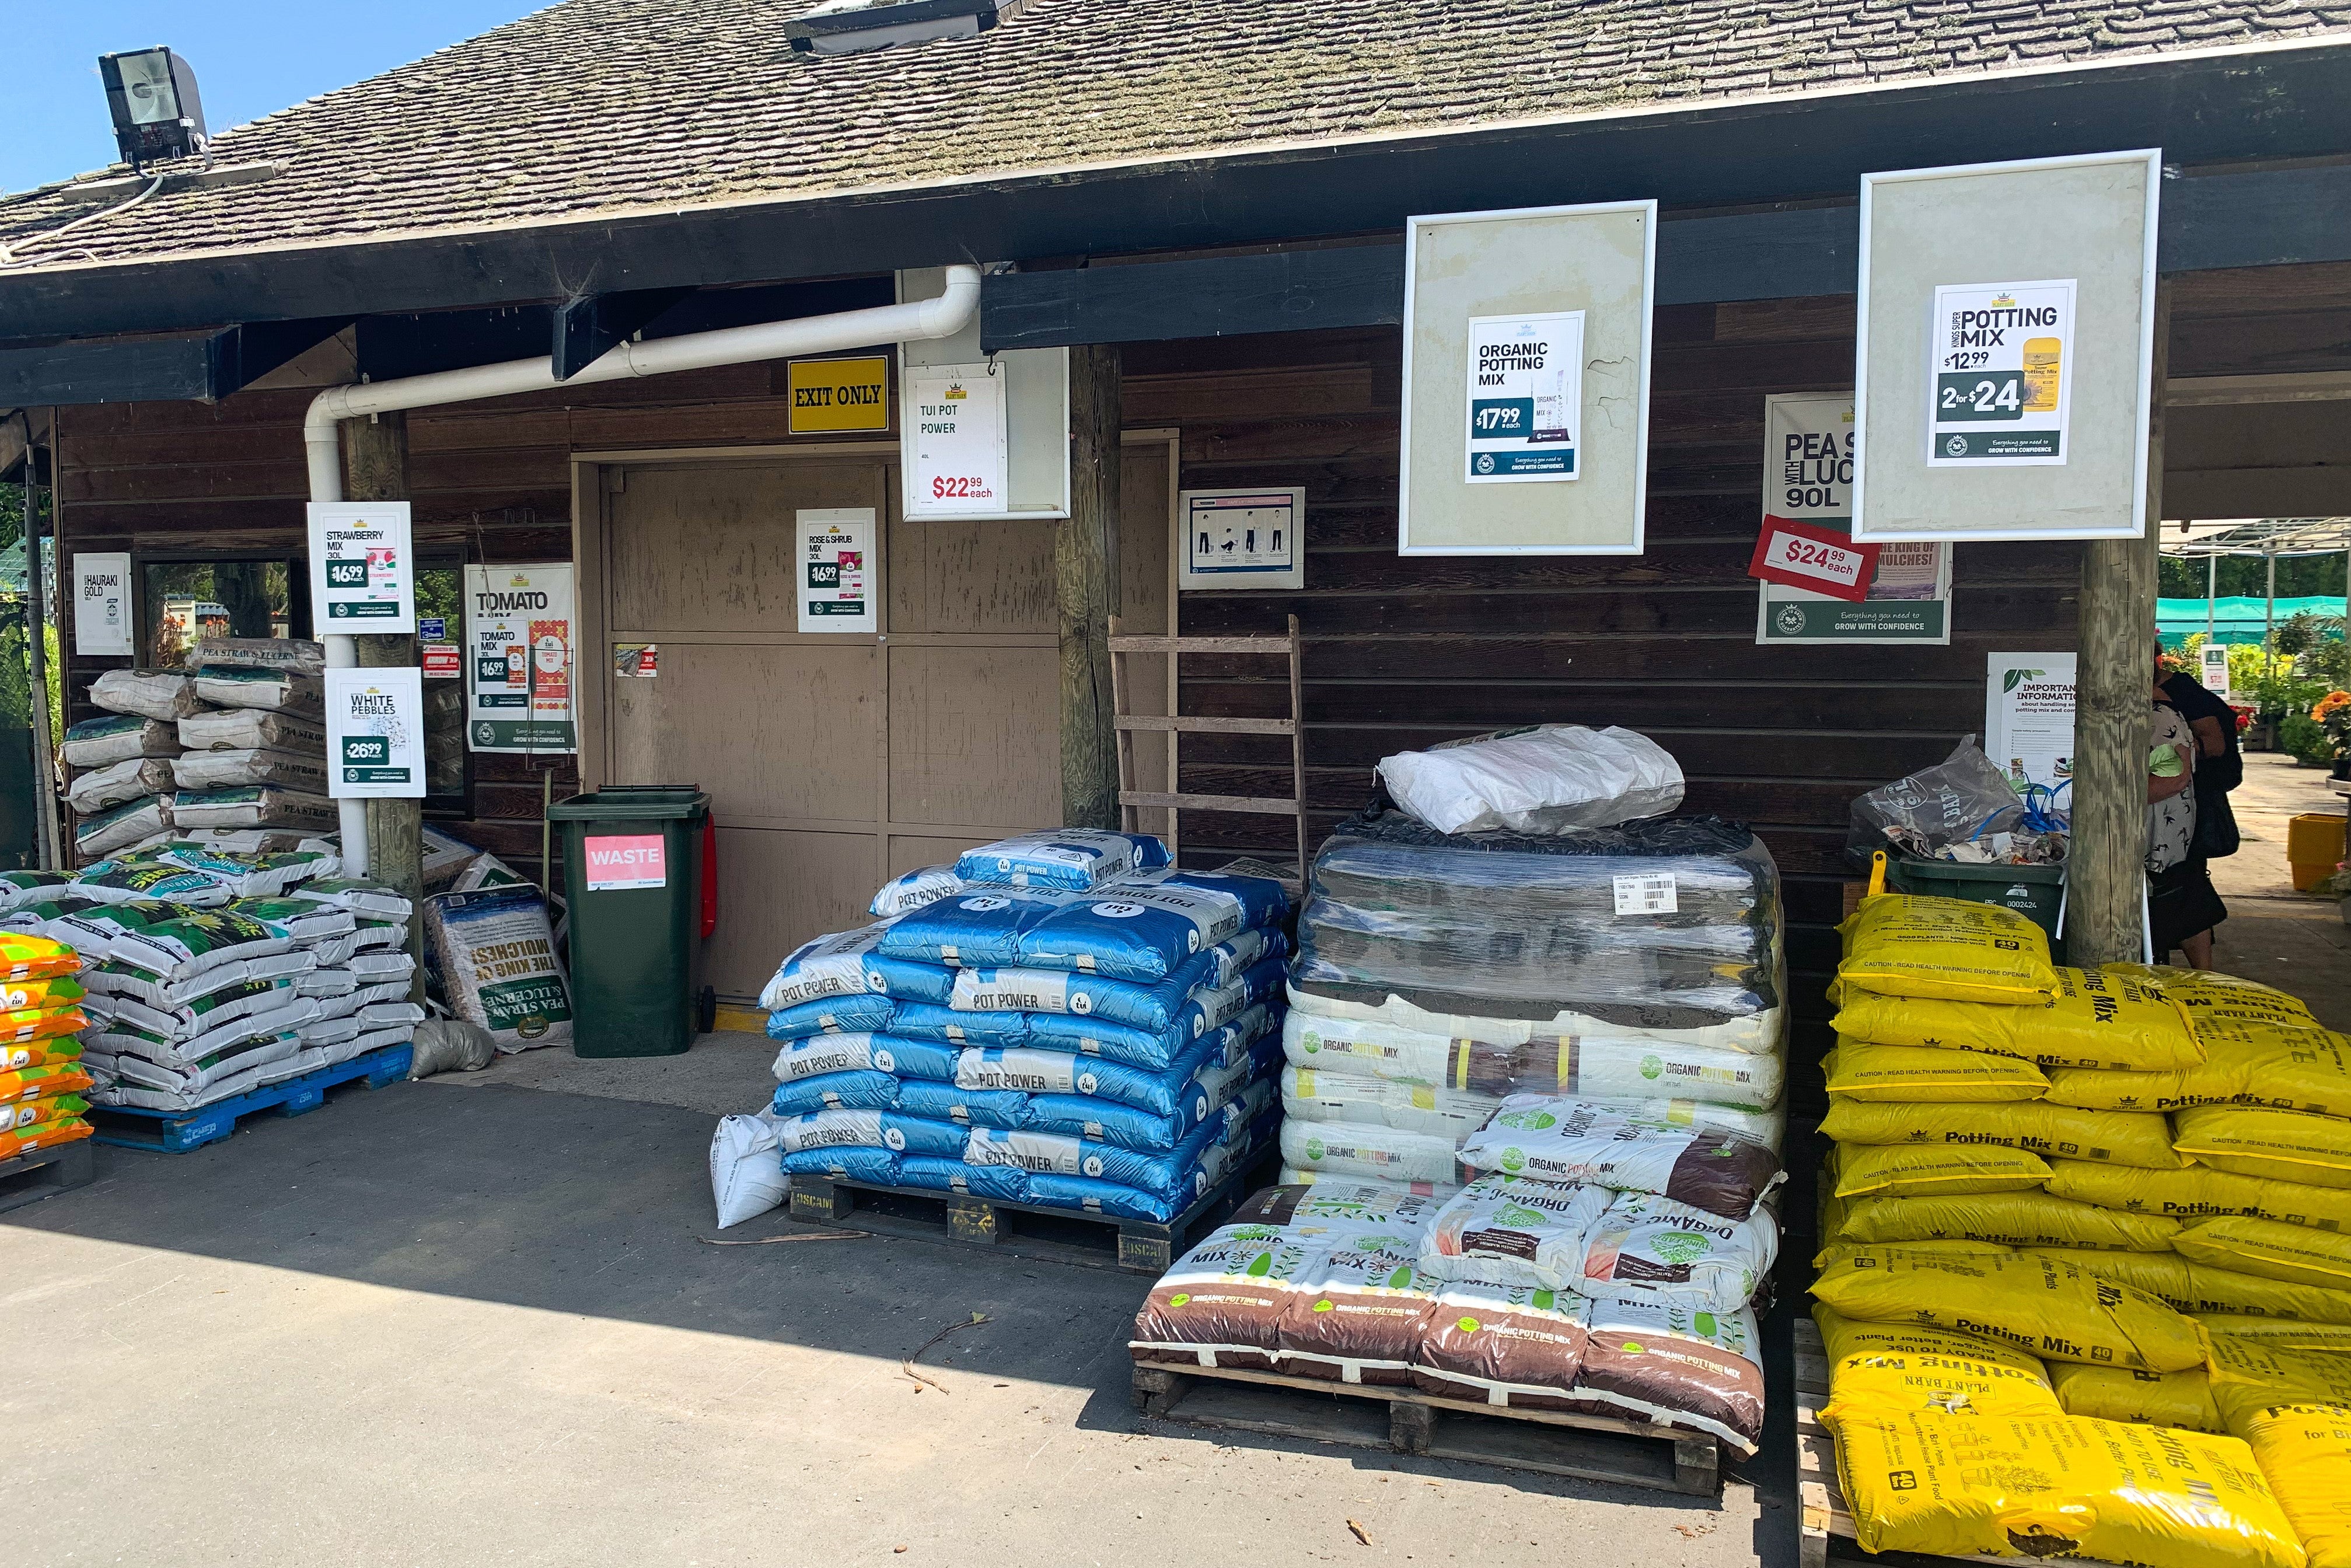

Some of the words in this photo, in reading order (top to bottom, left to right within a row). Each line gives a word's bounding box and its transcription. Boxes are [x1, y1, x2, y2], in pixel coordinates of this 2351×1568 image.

[1962, 307, 2057, 329] POTTING
[1951, 330, 1959, 348] KINGS
[1961, 329, 2005, 347] MIX
[1479, 342, 1548, 358] ORGANIC
[1479, 357, 1544, 372] POTTING
[1479, 373, 1505, 386] MIX
[795, 387, 833, 407] EXIT
[837, 385, 882, 405] ONLY
[1942, 387, 1957, 408] 2
[1956, 393, 1968, 403] for
[1969, 379, 2020, 411] $24
[920, 406, 935, 416] TUI
[939, 405, 958, 415] POT
[921, 423, 956, 434] POWER
[1786, 433, 1838, 460] PEA
[1784, 461, 1799, 485] WITH
[933, 476, 969, 499] $22
[970, 488, 992, 498] each
[1786, 487, 1840, 508] 90L
[327, 530, 384, 540] STRAWBERRY
[809, 536, 825, 544] ROSE
[831, 535, 852, 543] SHRUB
[327, 542, 343, 550] MIX
[809, 544, 822, 553] MIX
[1880, 542, 1893, 553] HE
[1895, 542, 1920, 553] KING
[1922, 542, 1936, 552] OF
[1786, 539, 1830, 568] $24
[1878, 554, 1933, 566] MULCHES!
[1828, 563, 1853, 575] each
[87, 574, 118, 586] HAURAKI
[84, 586, 103, 597] GOLD
[476, 591, 548, 611] TOMATO
[1841, 612, 1877, 621] Everything
[1878, 613, 1892, 621] you
[1835, 623, 1857, 631] GROW
[1878, 622, 1924, 630] CONFIDENCE
[480, 631, 515, 642] TOMATO
[202, 648, 219, 657] PEA
[219, 649, 249, 658] STRAW
[481, 642, 497, 651] MIX
[351, 695, 394, 706] WHITE
[351, 706, 396, 715] PEBBLES
[591, 848, 660, 866] WASTE
[1000, 861, 1008, 870] tui
[1015, 864, 1026, 873] POT
[1026, 864, 1047, 875] POWER
[898, 893, 917, 909] POT
[920, 886, 956, 903] POWER
[470, 938, 550, 965] MULCHES!
[494, 961, 532, 977] KING
[533, 956, 557, 972] THE
[1916, 963, 1941, 971] HEALTH
[1942, 964, 1973, 973] WARNING
[1974, 968, 2001, 976] BEFORE
[781, 984, 802, 1003] POT
[803, 977, 841, 996] POWER
[12, 994, 23, 1005] tui
[485, 987, 552, 1008] LUCERNE
[540, 998, 567, 1011] PEA
[973, 993, 994, 1009] POT
[997, 993, 1039, 1009] POWER
[1075, 997, 1088, 1010] tui
[493, 1000, 539, 1020] STRAW
[1323, 1039, 1353, 1053] ORGANIC
[1353, 1042, 1383, 1056] POTTING
[1384, 1046, 1398, 1059] MIX
[979, 1071, 1004, 1088] POT
[1004, 1073, 1047, 1090] POWER
[1081, 1077, 1094, 1091] tui
[1945, 1131, 2014, 1147] Potting
[2020, 1136, 2052, 1150] Mix
[1528, 1157, 1567, 1174] ORGANIC
[1599, 1162, 1615, 1174] MIX
[2208, 1232, 2240, 1244] CAUTION
[2244, 1239, 2265, 1248] READ
[2265, 1243, 2293, 1253] HEALTH
[2294, 1248, 2327, 1260] WARNING
[2328, 1253, 2351, 1265] BEFOR
[1192, 1294, 1225, 1304] ORGANIC
[1224, 1295, 1258, 1305] POTTING
[1258, 1298, 1274, 1307] MIX
[1854, 1334, 1895, 1342] Plants
[1899, 1336, 1943, 1345] Better
[1956, 1318, 2036, 1349] Potting
[2042, 1335, 2084, 1358] Mix
[2094, 1347, 2110, 1358] 40
[1885, 1344, 1915, 1353] USE
[1945, 1347, 1997, 1362] READY
[1647, 1347, 1687, 1361] ORGANIC
[1686, 1354, 1724, 1374] POTTING
[1724, 1366, 1741, 1380] MIX
[1846, 1356, 1906, 1370] Mix
[1918, 1356, 2048, 1390] Potting
[1904, 1375, 1941, 1388] BARN
[1946, 1380, 1990, 1393] PLANT
[2304, 1429, 2327, 1440] for
